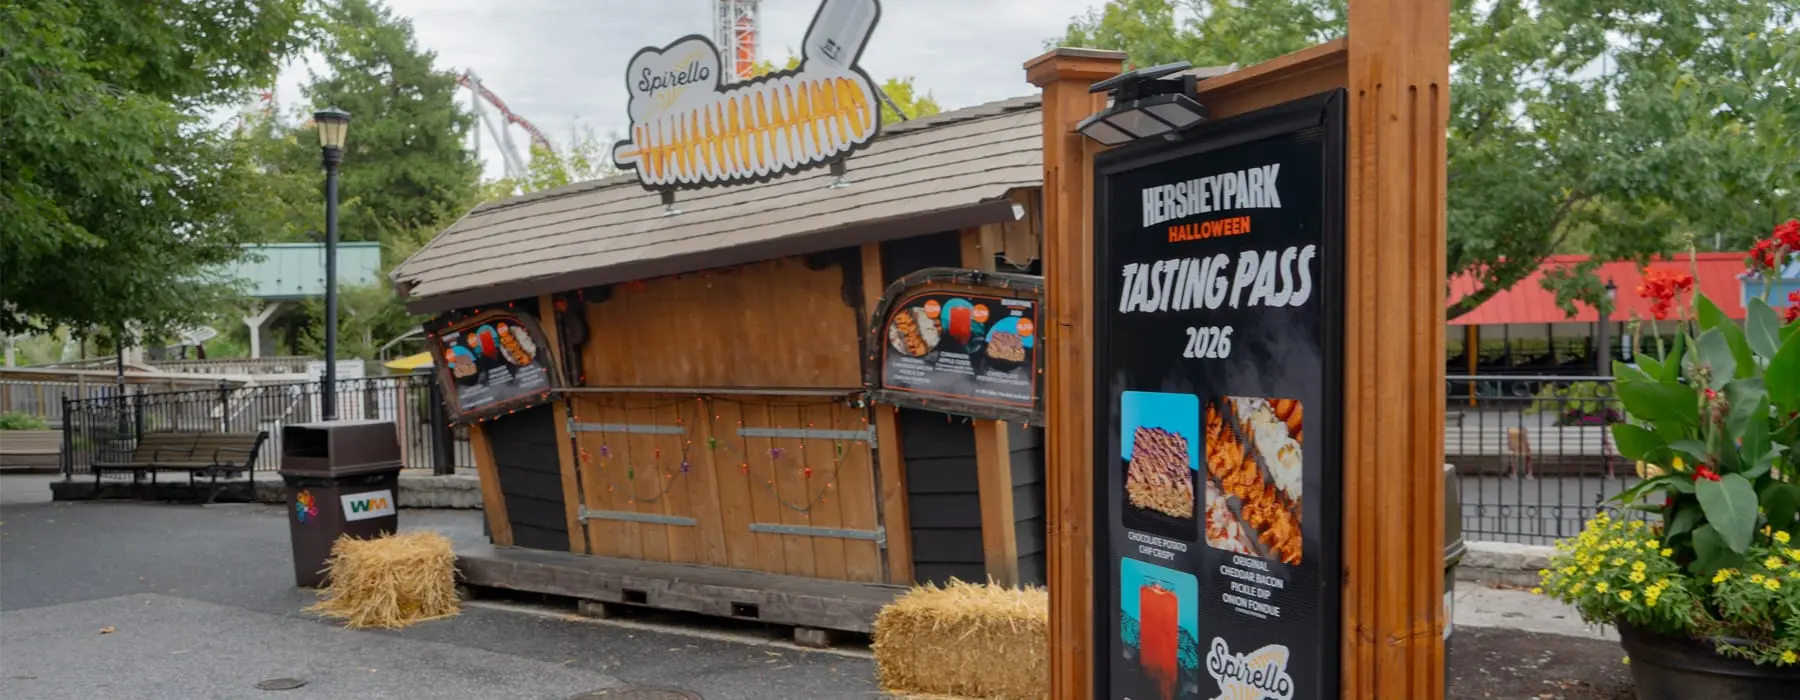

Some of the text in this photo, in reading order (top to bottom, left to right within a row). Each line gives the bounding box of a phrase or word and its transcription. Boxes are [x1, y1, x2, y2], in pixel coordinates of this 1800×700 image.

[638, 61, 710, 97] Spirello
[1142, 163, 1282, 228] HERSHEYPARK
[1167, 216, 1251, 243] HALLOWEEN
[1118, 244, 1317, 314] TASTING PASS
[1182, 325, 1234, 359] 2026
[351, 497, 388, 513] WM
[1127, 531, 1187, 552] CHOCOLATE POTATO
[1153, 548, 1175, 561] CRISPY
[1233, 555, 1269, 571] ORIGINAL
[1220, 565, 1284, 589] CHEDDAR BACON
[1230, 581, 1271, 600] PICKLE DIP
[1222, 593, 1248, 608] ONION
[1248, 600, 1280, 617] FONDUE
[1209, 642, 1290, 697] Spirello
